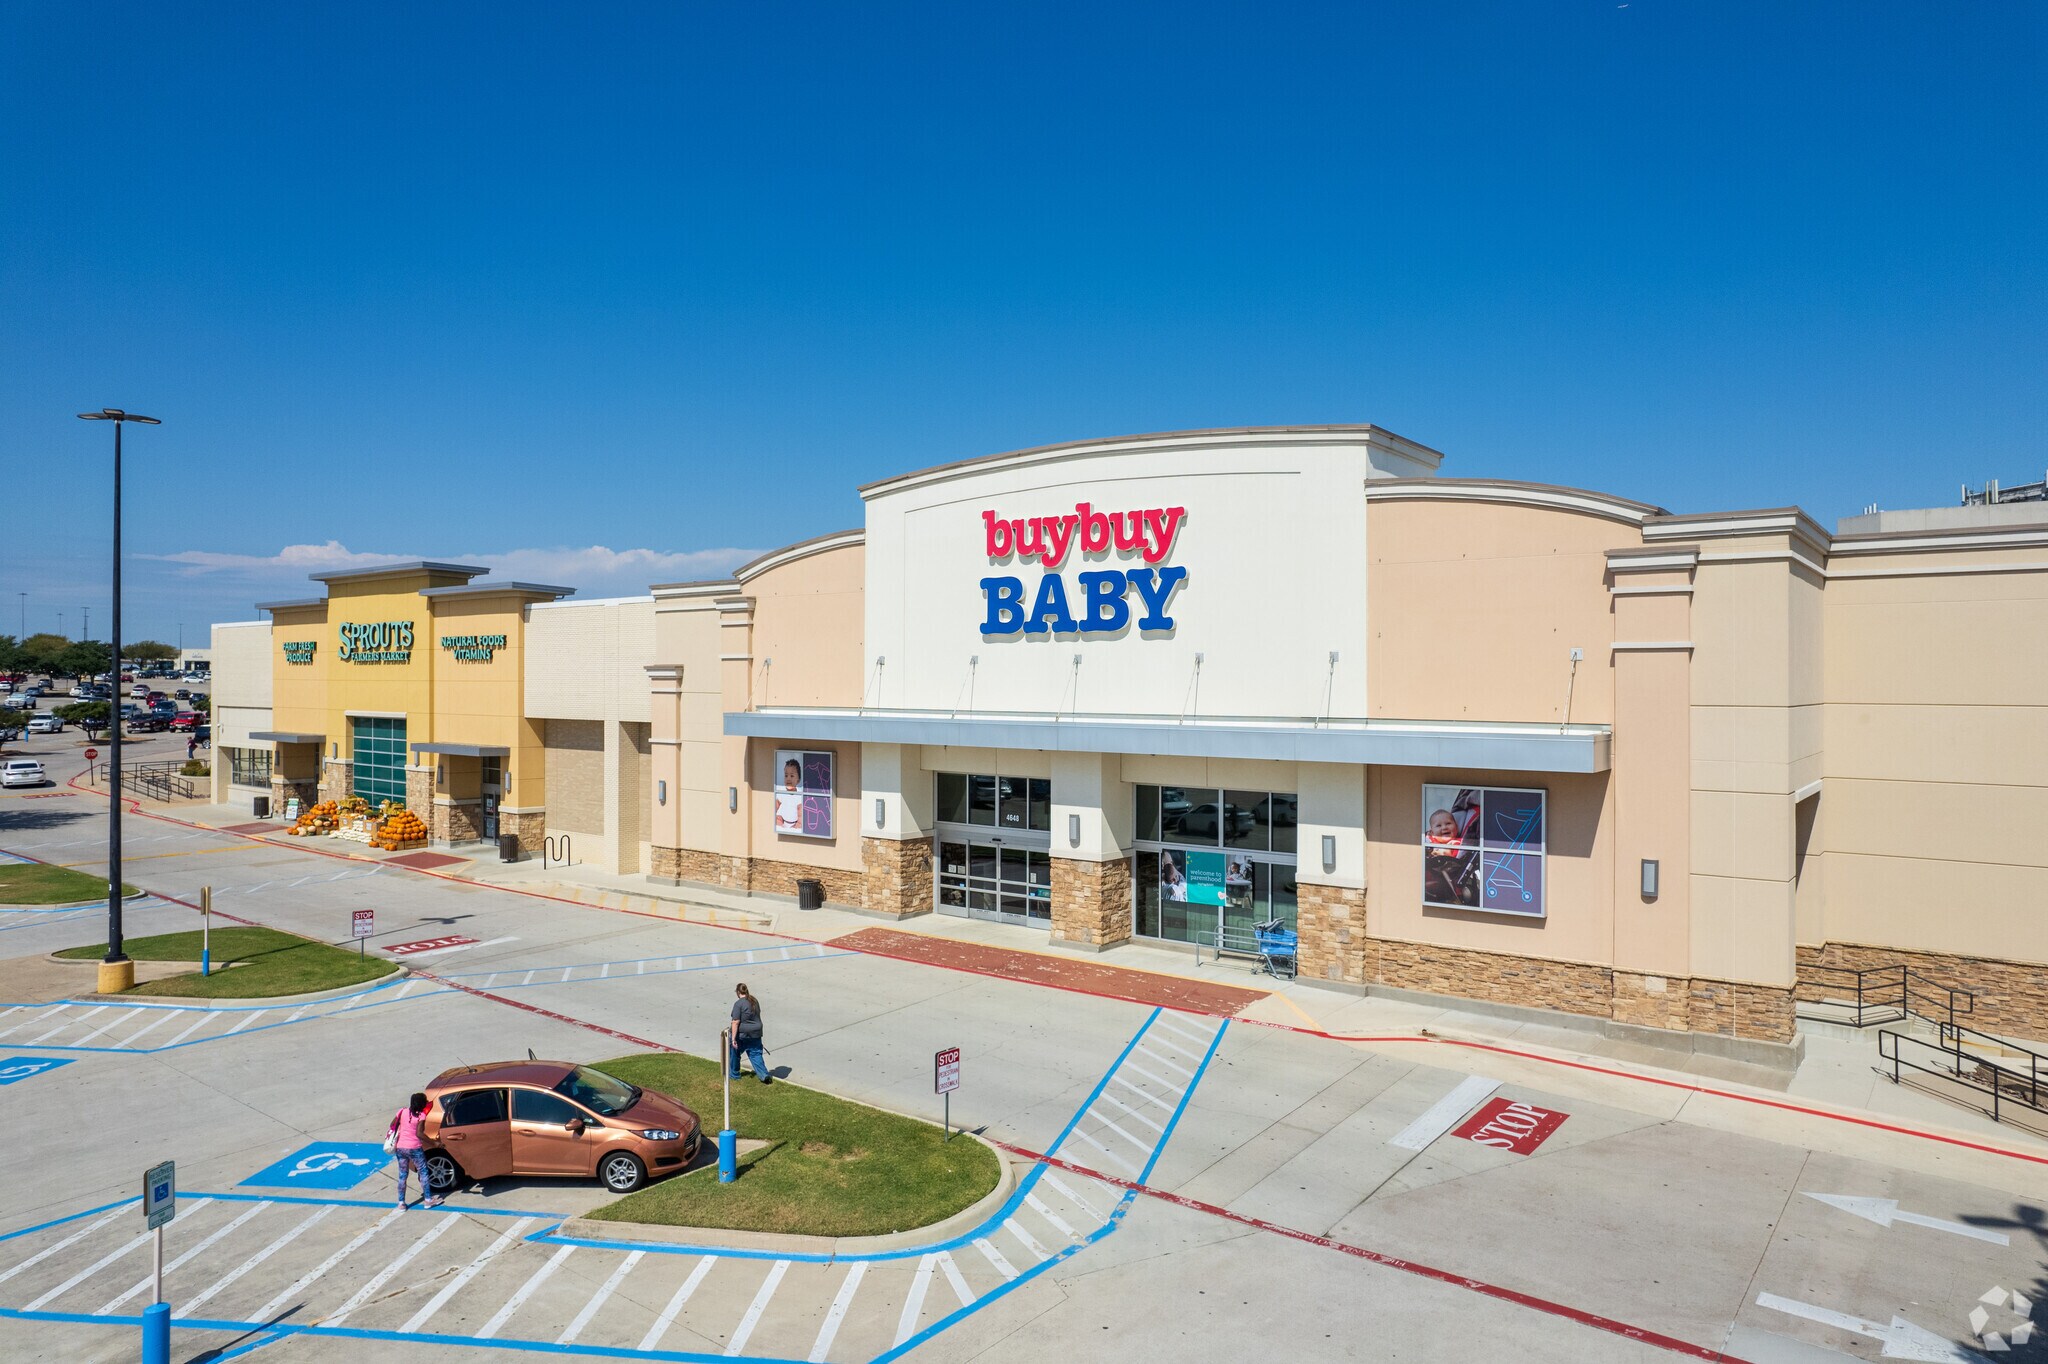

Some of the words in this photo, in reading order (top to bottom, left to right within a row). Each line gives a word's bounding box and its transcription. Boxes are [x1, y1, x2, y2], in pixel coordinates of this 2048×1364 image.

[981, 501, 1185, 568] buybuy
[979, 566, 1188, 636] BABY
[338, 621, 412, 659] SPROUTS
[441, 636, 477, 647] NATURAL
[479, 635, 505, 646] FOODS
[283, 642, 298, 651] FARM
[299, 641, 315, 651] FRESH
[286, 653, 311, 662] PRODUCE
[351, 652, 380, 661] FARMERS
[380, 651, 409, 661] MARKET
[453, 649, 491, 660] VITAMINS
[1006, 814, 1020, 822] 4648
[1190, 869, 1215, 877] welcome
[1190, 875, 1222, 883] parenthood
[355, 911, 373, 920] STOP
[393, 937, 473, 953] STOP
[939, 1051, 959, 1066] STOP
[939, 1068, 959, 1078] PEDESTRIAN
[939, 1080, 958, 1089] CROSSWALK
[1470, 1102, 1549, 1152] STOP
[150, 1166, 173, 1179] RESERVED
[152, 1173, 172, 1186] PARKING
